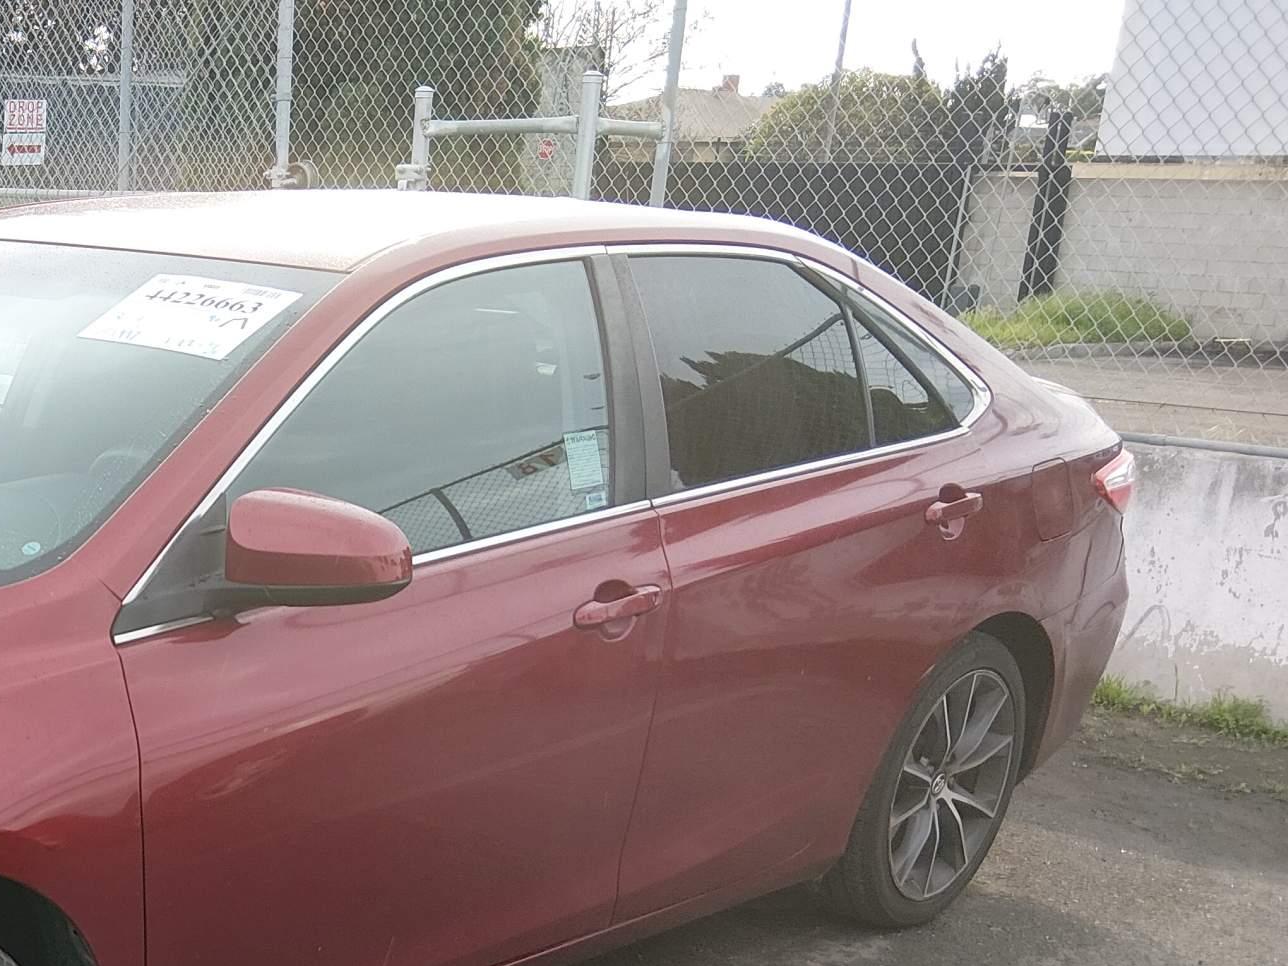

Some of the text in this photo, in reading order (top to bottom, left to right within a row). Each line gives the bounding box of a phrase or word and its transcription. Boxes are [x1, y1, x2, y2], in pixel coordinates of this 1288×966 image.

[9, 101, 43, 113] DROP
[9, 114, 43, 126] ZONE
[145, 289, 263, 314] 44226663
